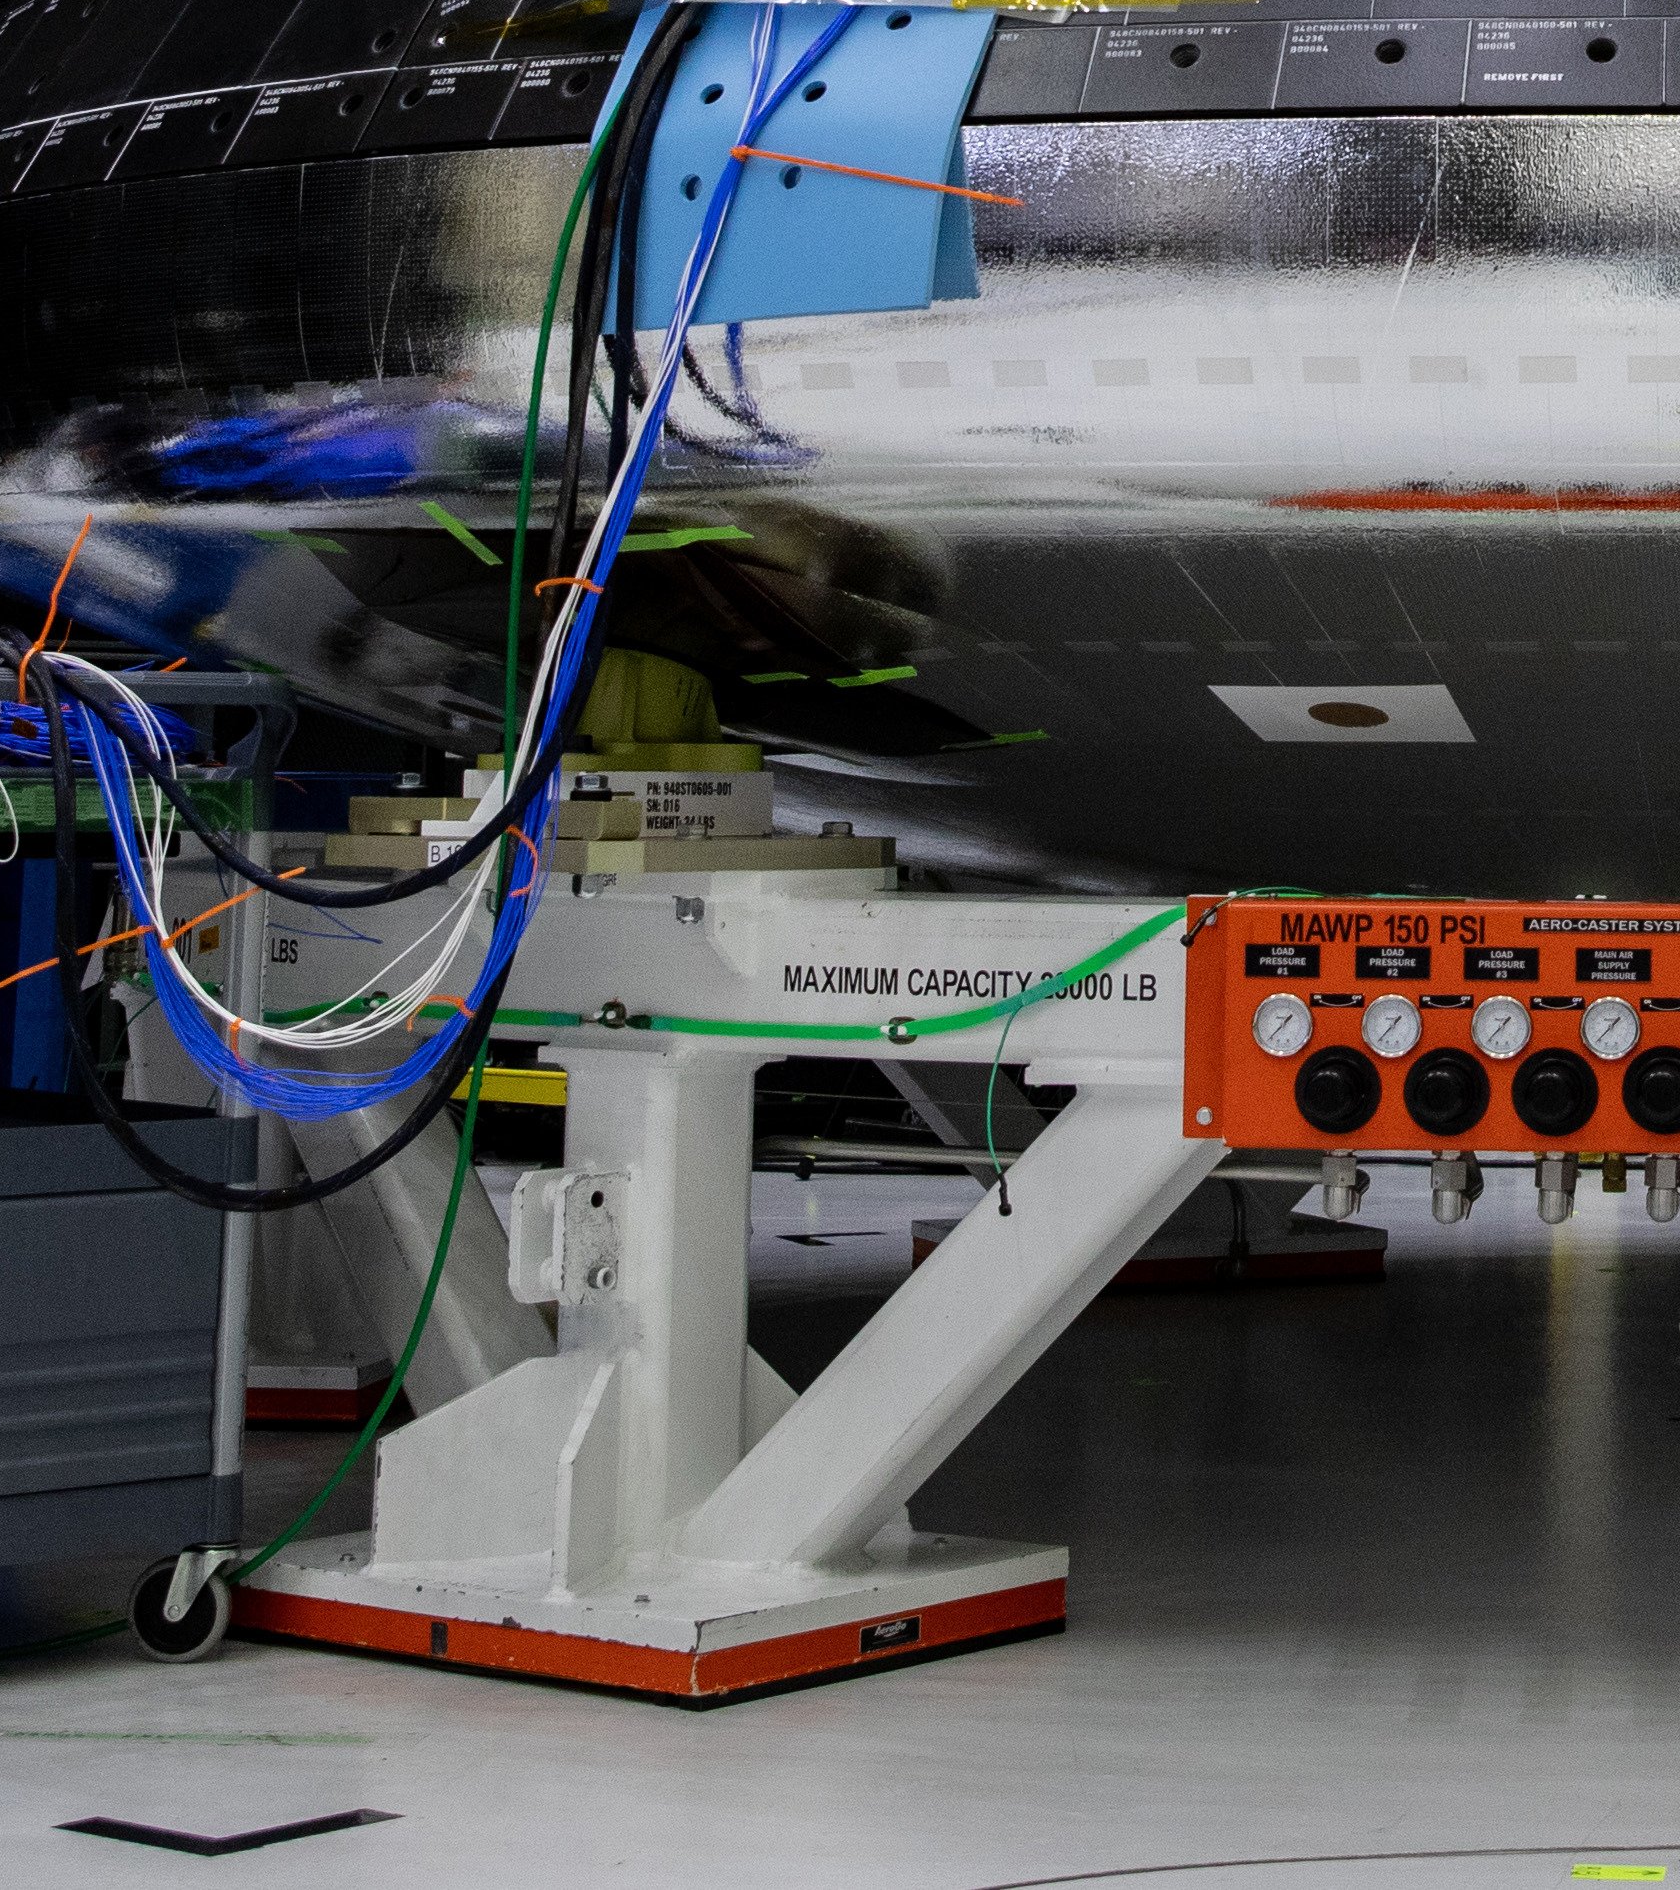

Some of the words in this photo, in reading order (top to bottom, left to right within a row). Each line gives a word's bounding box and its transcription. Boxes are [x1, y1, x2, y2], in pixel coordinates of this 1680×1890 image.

[1483, 73, 1528, 81] REMOVE
[1531, 73, 1564, 82] FIRST
[646, 782, 661, 795] PN:
[646, 798, 661, 812] SN:
[663, 798, 680, 812] 016
[430, 845, 441, 863] B
[1280, 913, 1372, 943] MAWP
[1384, 914, 1429, 944] 150
[1440, 915, 1486, 945] PSI
[1529, 919, 1640, 932] AERO-CASTER
[271, 937, 299, 964] LBS
[1271, 948, 1295, 956] LOAD
[1381, 948, 1405, 957] LOAD
[1490, 950, 1513, 959] LOAD
[1594, 951, 1618, 959] MAIN
[1620, 951, 1633, 959] AIR
[1259, 957, 1306, 966] PRESSURE
[1369, 958, 1416, 967] PRESSURE
[1478, 960, 1526, 969] PRESSURE
[1598, 961, 1630, 970] SUPPLY
[1277, 967, 1289, 976] #1
[1386, 968, 1398, 977] #2
[1496, 971, 1508, 979] #3
[1591, 972, 1636, 980] PRESSURE
[783, 965, 900, 996] MAXIMUM
[908, 967, 1033, 999] CAPACITY
[1123, 973, 1158, 1002] LB
[873, 1620, 908, 1637] AeroGo
